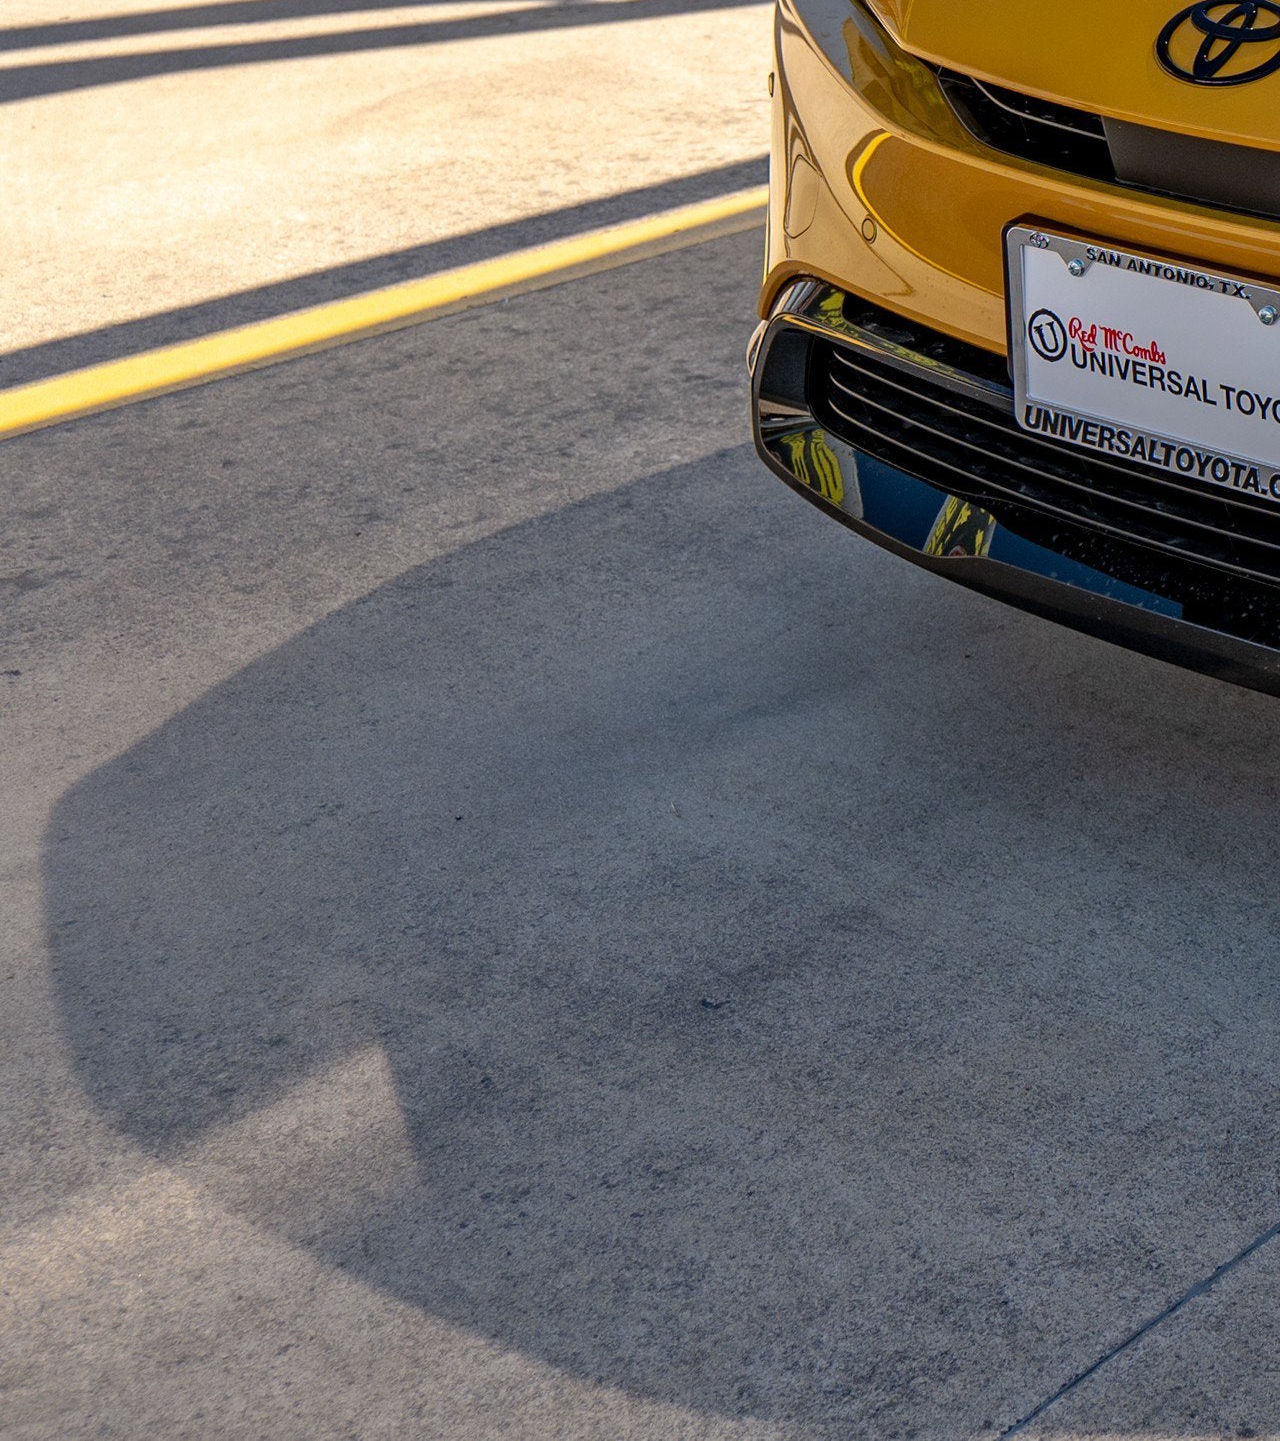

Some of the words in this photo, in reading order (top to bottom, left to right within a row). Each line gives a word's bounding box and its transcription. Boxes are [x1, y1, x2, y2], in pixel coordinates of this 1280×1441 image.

[1086, 246, 1122, 268] SAN
[1126, 257, 1215, 291] ANTONIO,
[1068, 317, 1098, 352] Red
[1099, 323, 1167, 365] McCombs
[1070, 343, 1218, 407] UNIVERSAL
